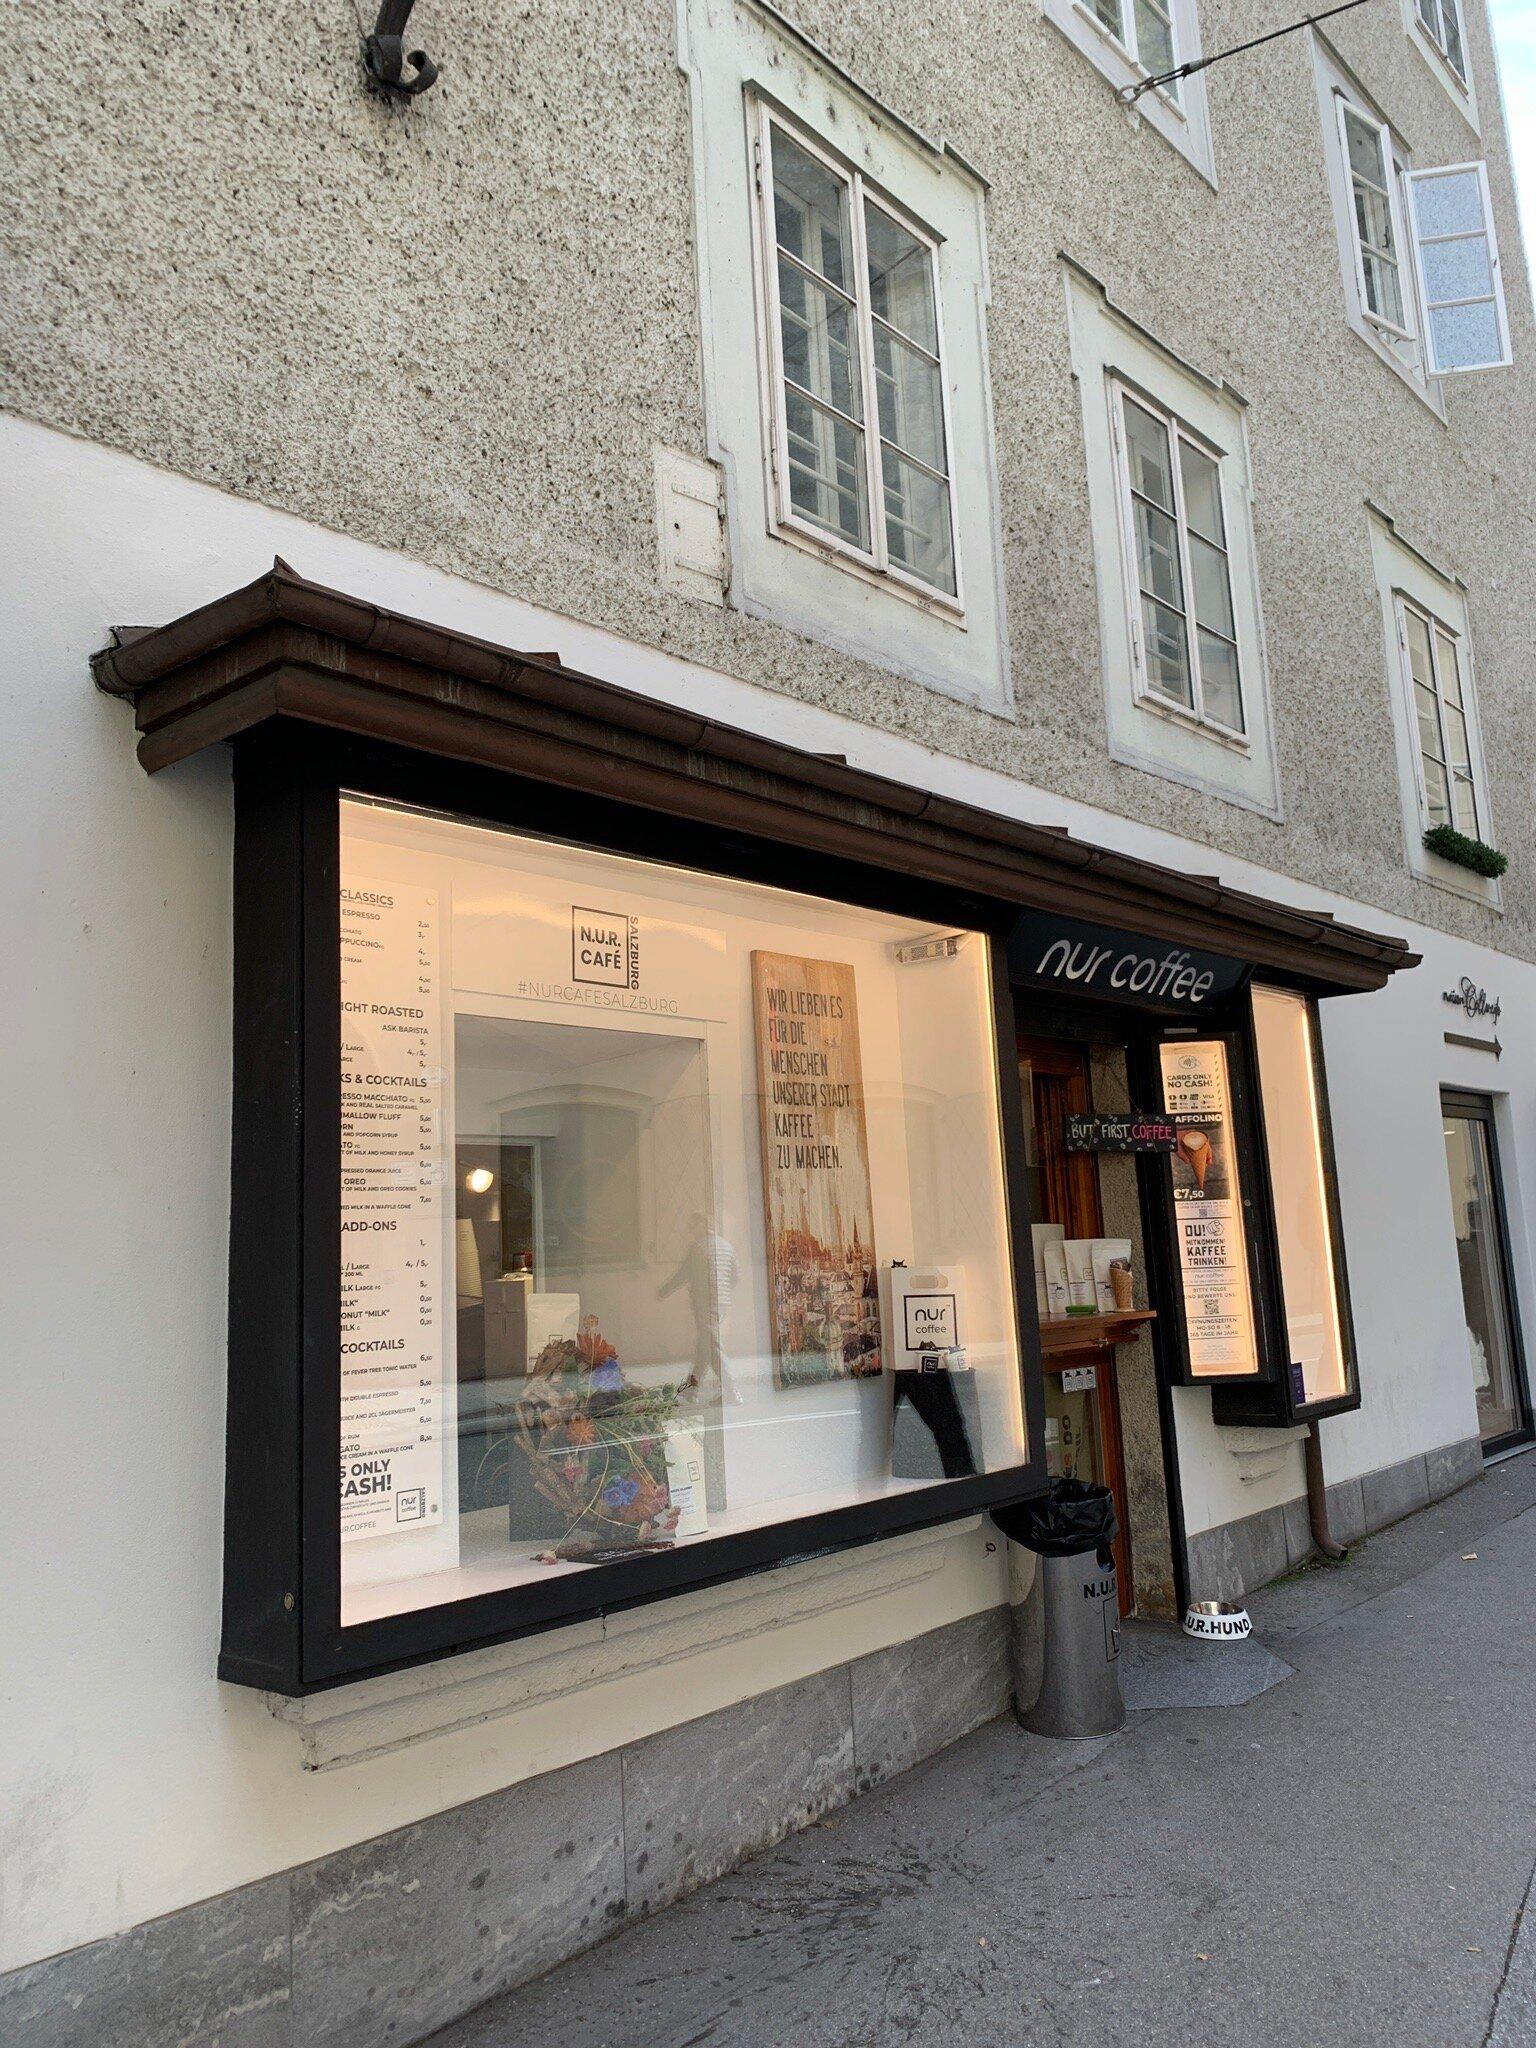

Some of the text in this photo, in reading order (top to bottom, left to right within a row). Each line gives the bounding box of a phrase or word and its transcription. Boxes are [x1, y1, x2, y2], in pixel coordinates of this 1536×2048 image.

[340, 889, 394, 906] CLASSICS
[342, 909, 380, 920] ESPRESSO
[581, 926, 621, 947] N.U.R.
[581, 949, 621, 969] CAFÉ
[630, 916, 639, 990] SALZBURG
[1036, 939, 1214, 1002] nur coffee
[518, 980, 678, 1013] #NURCAFESALZBURG
[767, 988, 843, 1019] WIR LIEBEN ES
[372, 1004, 424, 1019] ROASTED
[382, 1024, 429, 1035] ASK BARISTA
[769, 1016, 807, 1045] FÜR DIE
[771, 1050, 828, 1076] MENSCHEN
[355, 1074, 362, 1083] &
[366, 1075, 427, 1087] COCKTAILS
[364, 1094, 408, 1103] MACCHIATO
[773, 1081, 850, 1107] UNSERER STADT
[379, 1113, 402, 1121] FLUFF
[775, 1113, 813, 1138] KAFFEE
[1071, 1124, 1172, 1139] BUT FIRST COFFEE
[777, 1145, 843, 1169] ZU MACHEN.
[1173, 1189, 1204, 1200] €7,50
[341, 1221, 397, 1231] ADD-ONS
[1185, 1224, 1206, 1237] DU!
[1187, 1246, 1226, 1256] KAFFEE
[1188, 1257, 1227, 1266] TRINKEN!
[915, 1308, 945, 1321] nur
[915, 1324, 947, 1334] coffee
[341, 1339, 405, 1354] COCKTAILS
[348, 1451, 367, 1459] CREAM
[351, 1459, 391, 1477] ONLY
